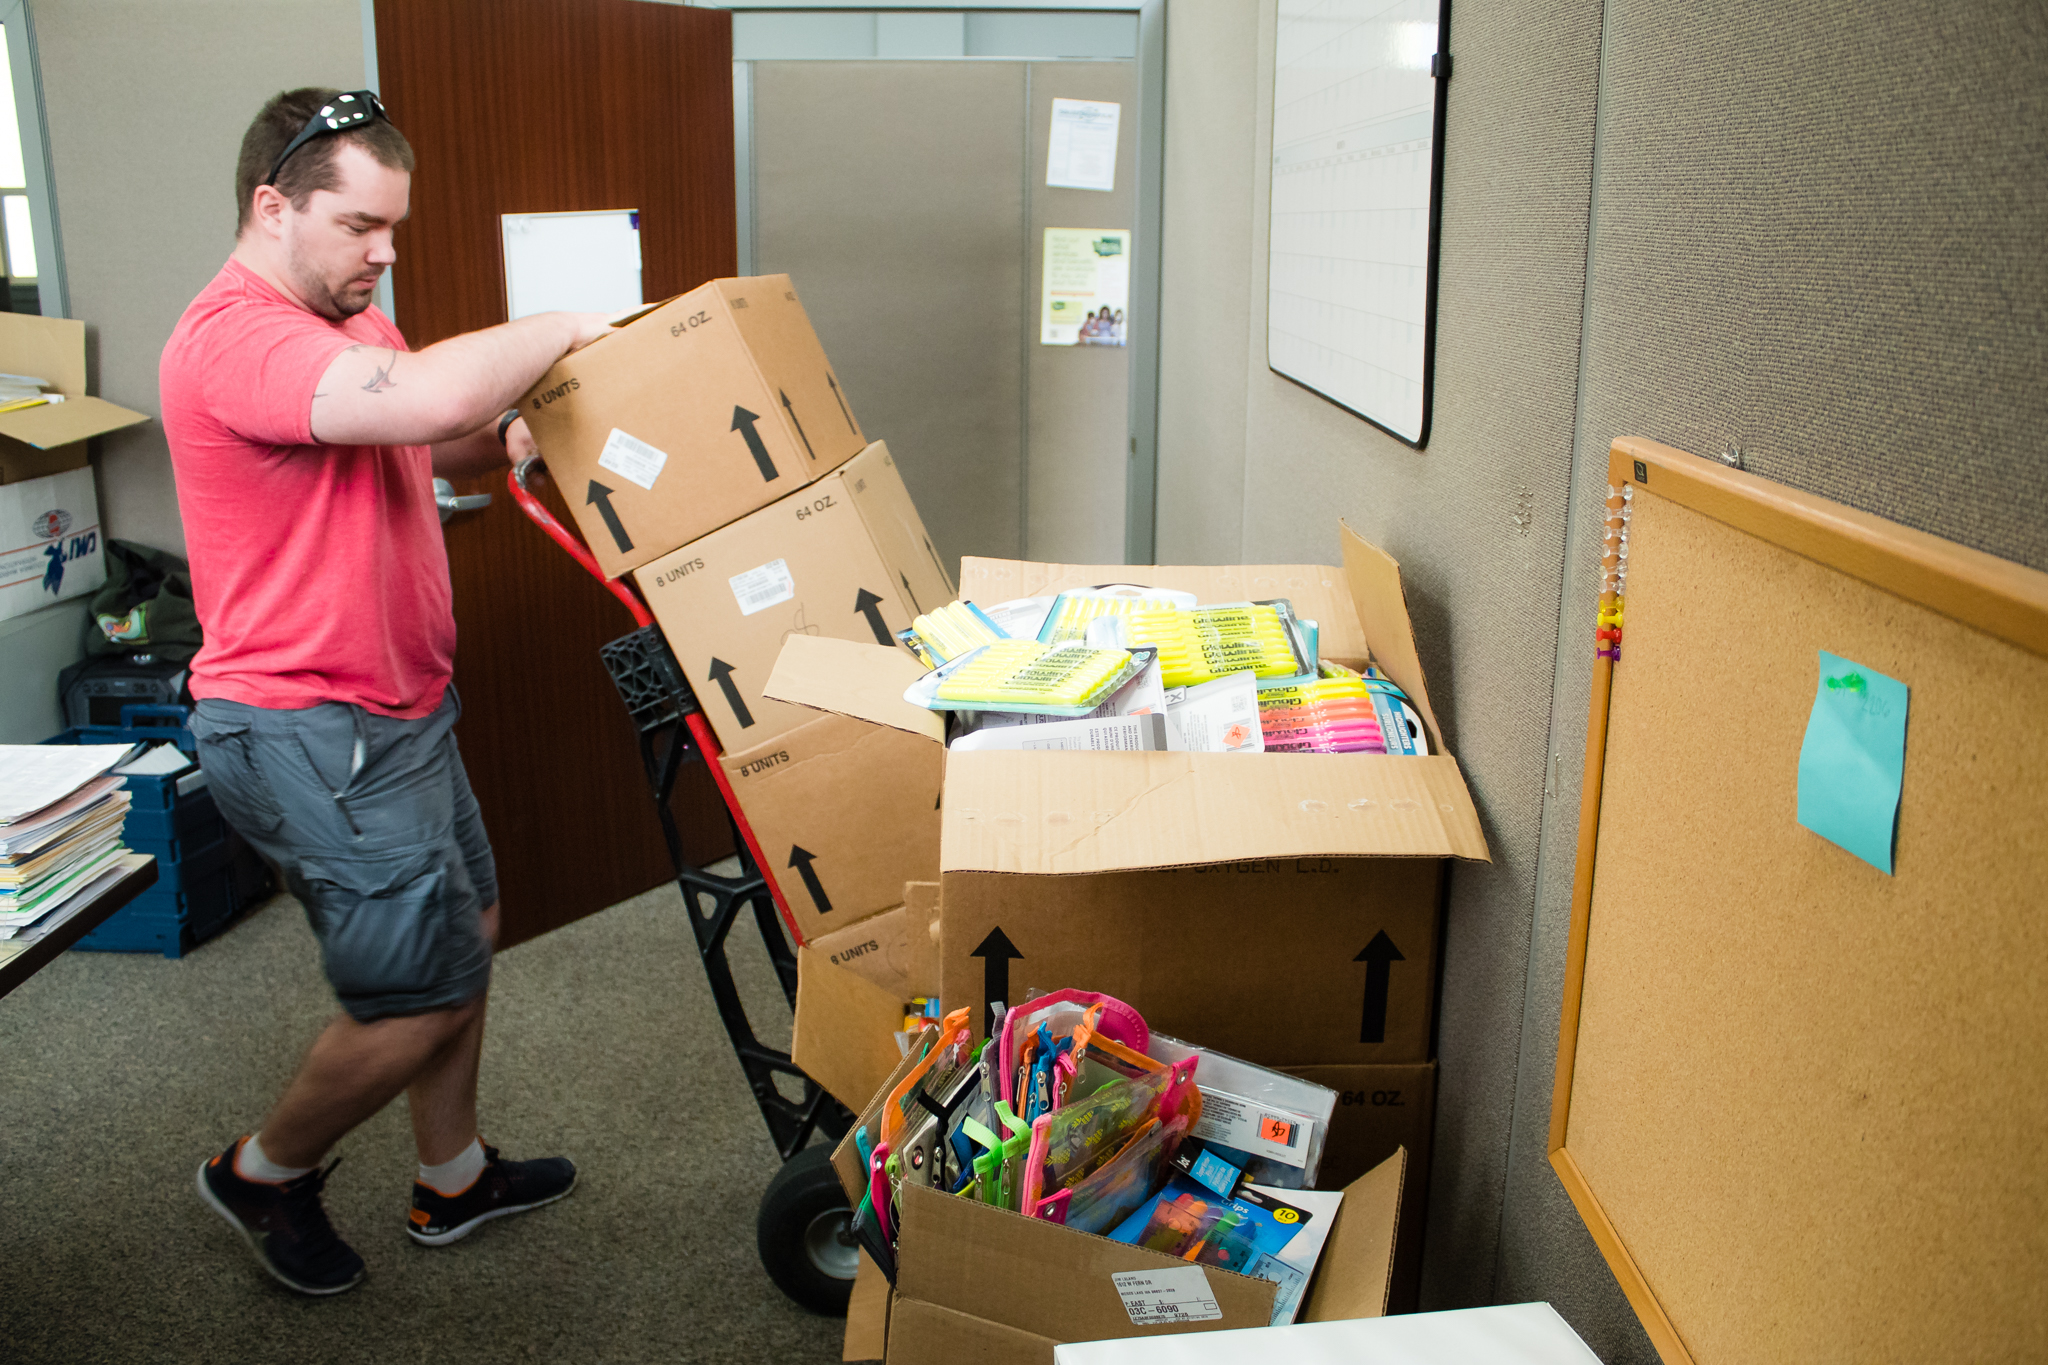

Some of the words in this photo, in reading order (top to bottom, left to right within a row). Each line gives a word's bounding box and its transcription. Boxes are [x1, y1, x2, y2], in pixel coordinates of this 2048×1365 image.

[671, 322, 689, 338] 64
[688, 309, 712, 329] OZ.
[532, 396, 542, 410] 8
[542, 377, 581, 407] UNITS
[796, 504, 813, 521] 64
[813, 494, 837, 514] OZ.
[656, 575, 666, 588] 8
[665, 557, 705, 584] UNITS
[1210, 664, 1271, 674] Glowline
[1382, 713, 1399, 749] SURLIGNEURS
[1394, 712, 1412, 749] HIGHLIGHTERS
[740, 765, 750, 778] 8
[749, 750, 790, 774] UNITS
[830, 954, 839, 966] 8
[839, 939, 880, 962] UNITS
[1341, 1090, 1366, 1107] 64
[1371, 1090, 1406, 1107] OZ.
[1221, 1199, 1250, 1214] Grips
[1277, 1209, 1297, 1220] 10
[1128, 1306, 1147, 1316] 03C
[1155, 1304, 1179, 1314] 6090
[1130, 1299, 1146, 1307] EAST
